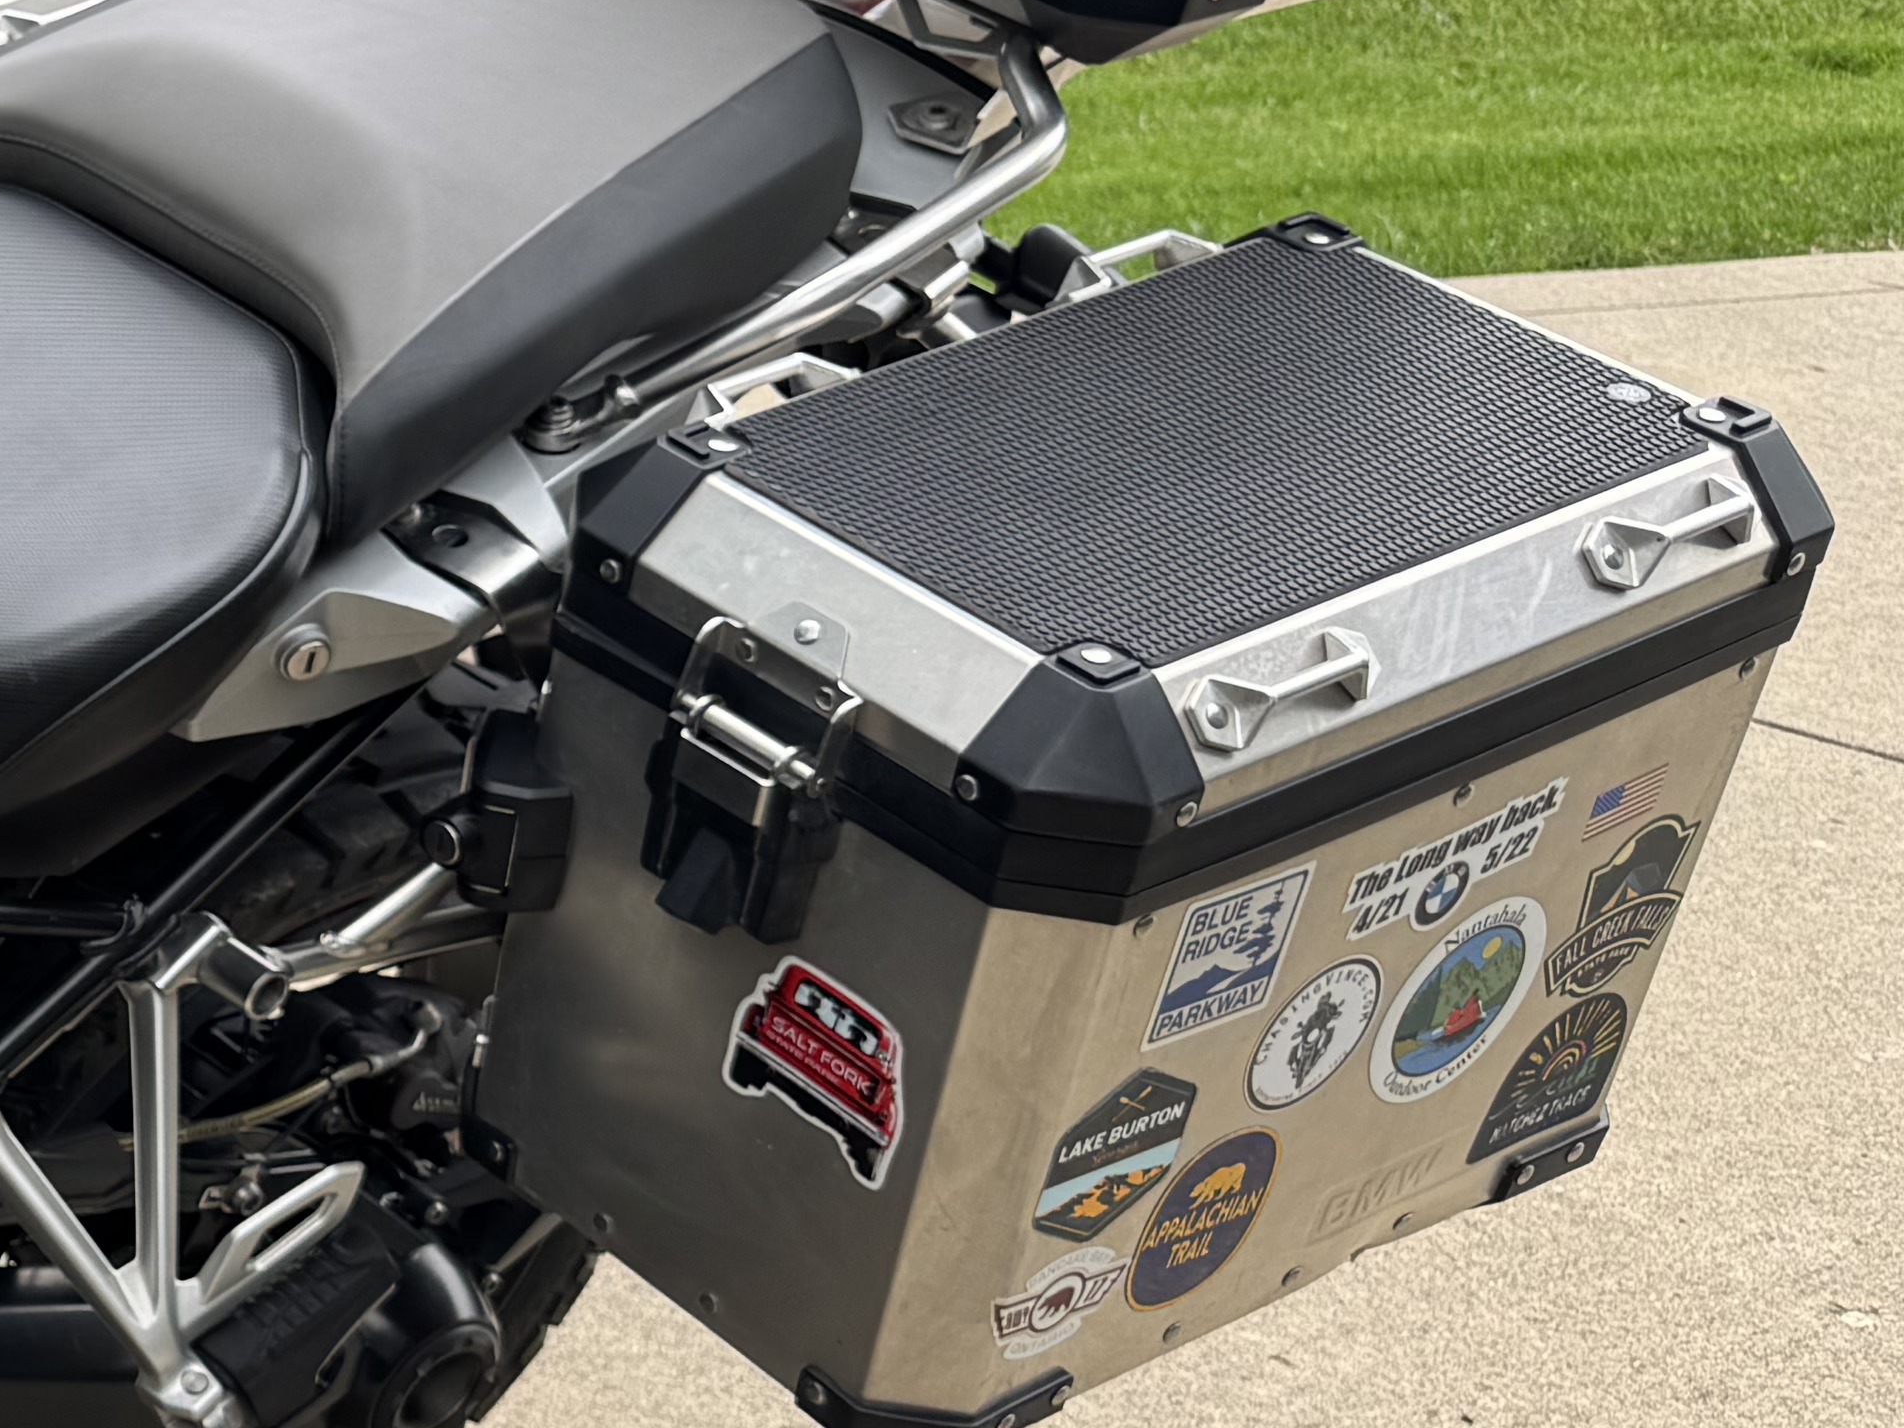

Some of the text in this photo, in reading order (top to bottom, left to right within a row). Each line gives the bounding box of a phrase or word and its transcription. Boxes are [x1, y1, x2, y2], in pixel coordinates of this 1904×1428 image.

[1349, 867, 1394, 905] The
[1393, 837, 1453, 884] Long
[1452, 814, 1502, 857] way
[1480, 826, 1539, 874] 5/22
[1191, 896, 1254, 937] BLUE
[1353, 887, 1409, 934] 4/21
[1444, 904, 1527, 954] Nantahala
[1555, 936, 1586, 975] FALL
[1591, 913, 1635, 950] CREEK
[1634, 900, 1670, 934] FALLS
[1182, 921, 1254, 963] RIDGE
[1155, 980, 1265, 1037] PARKWAY
[772, 1016, 875, 1096] SALT FORK
[1434, 1033, 1488, 1084] Center
[1058, 1131, 1105, 1163] LAKE
[1106, 1101, 1186, 1145] BURTON
[1316, 1146, 1443, 1233] BMW
[1141, 1186, 1266, 1251] APPALACHIAN
[1165, 1231, 1214, 1270] TRAIL
